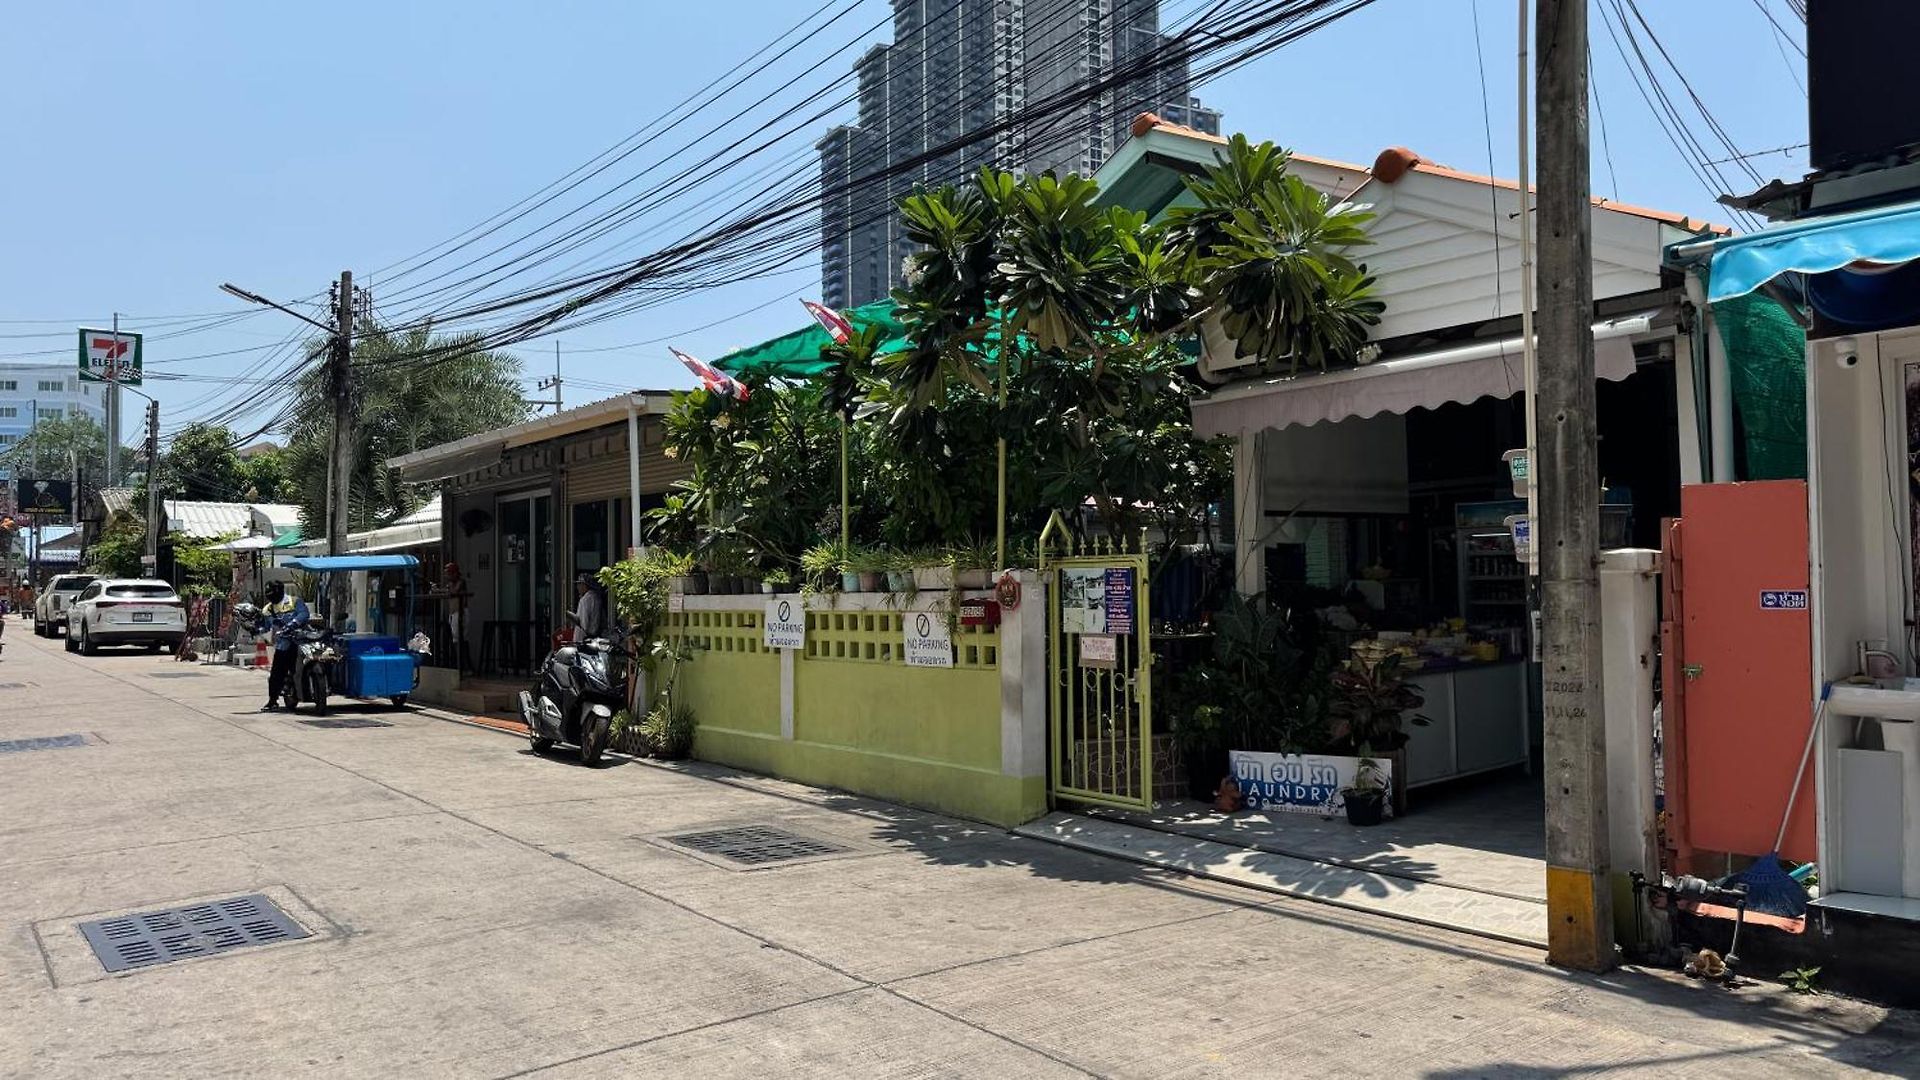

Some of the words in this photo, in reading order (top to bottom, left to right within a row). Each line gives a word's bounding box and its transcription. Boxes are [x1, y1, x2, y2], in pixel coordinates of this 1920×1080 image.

[92, 338, 128, 380] 7
[767, 622, 778, 632] NO
[778, 622, 804, 634] PARKING
[906, 639, 917, 650] NO
[918, 639, 949, 652] PARKING
[1238, 781, 1335, 801] LAUNDRY
